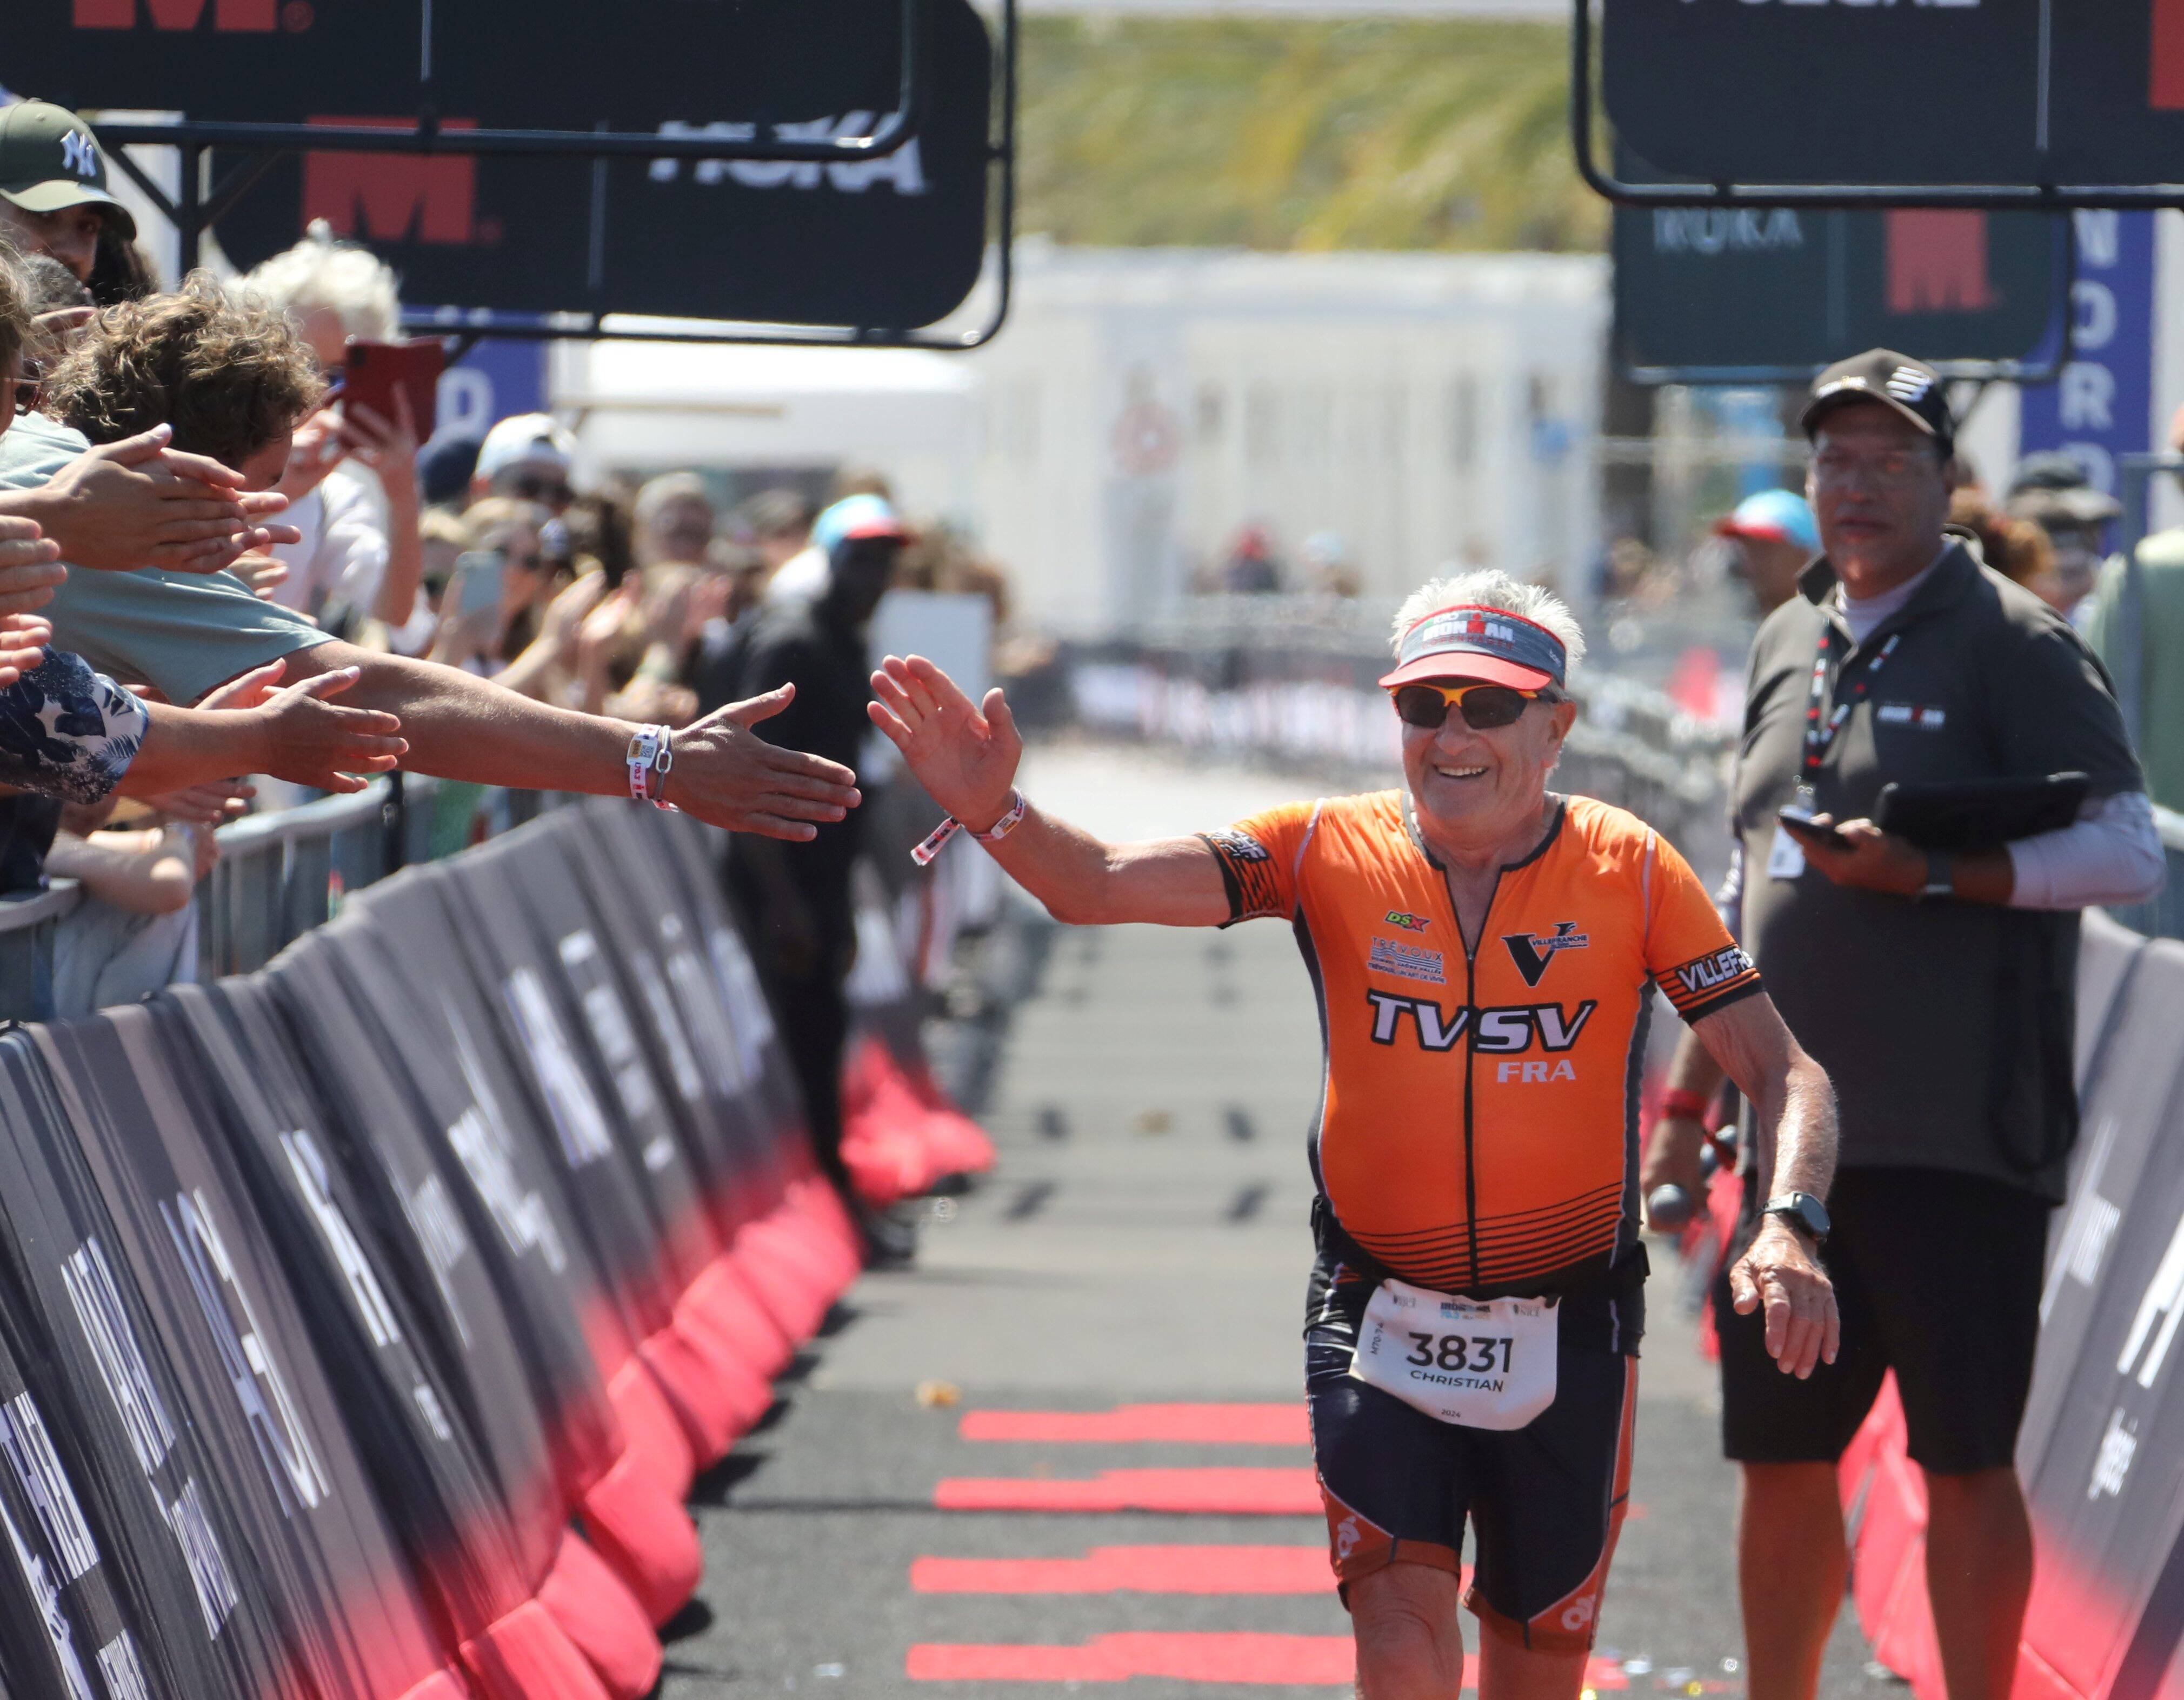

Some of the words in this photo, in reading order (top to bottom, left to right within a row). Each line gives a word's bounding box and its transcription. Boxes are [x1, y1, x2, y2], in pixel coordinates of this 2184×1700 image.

[60, 129, 96, 177] NY
[1385, 910, 1431, 932] DSX
[1532, 935, 1588, 946] VILLEFRANCHE
[1367, 988, 1597, 1053] TVSV
[1497, 1059, 1575, 1083] FRA
[1406, 1331, 1513, 1373] 3831
[1410, 1370, 1504, 1392] CHRISTIAN
[1441, 1409, 1461, 1418] 2024
